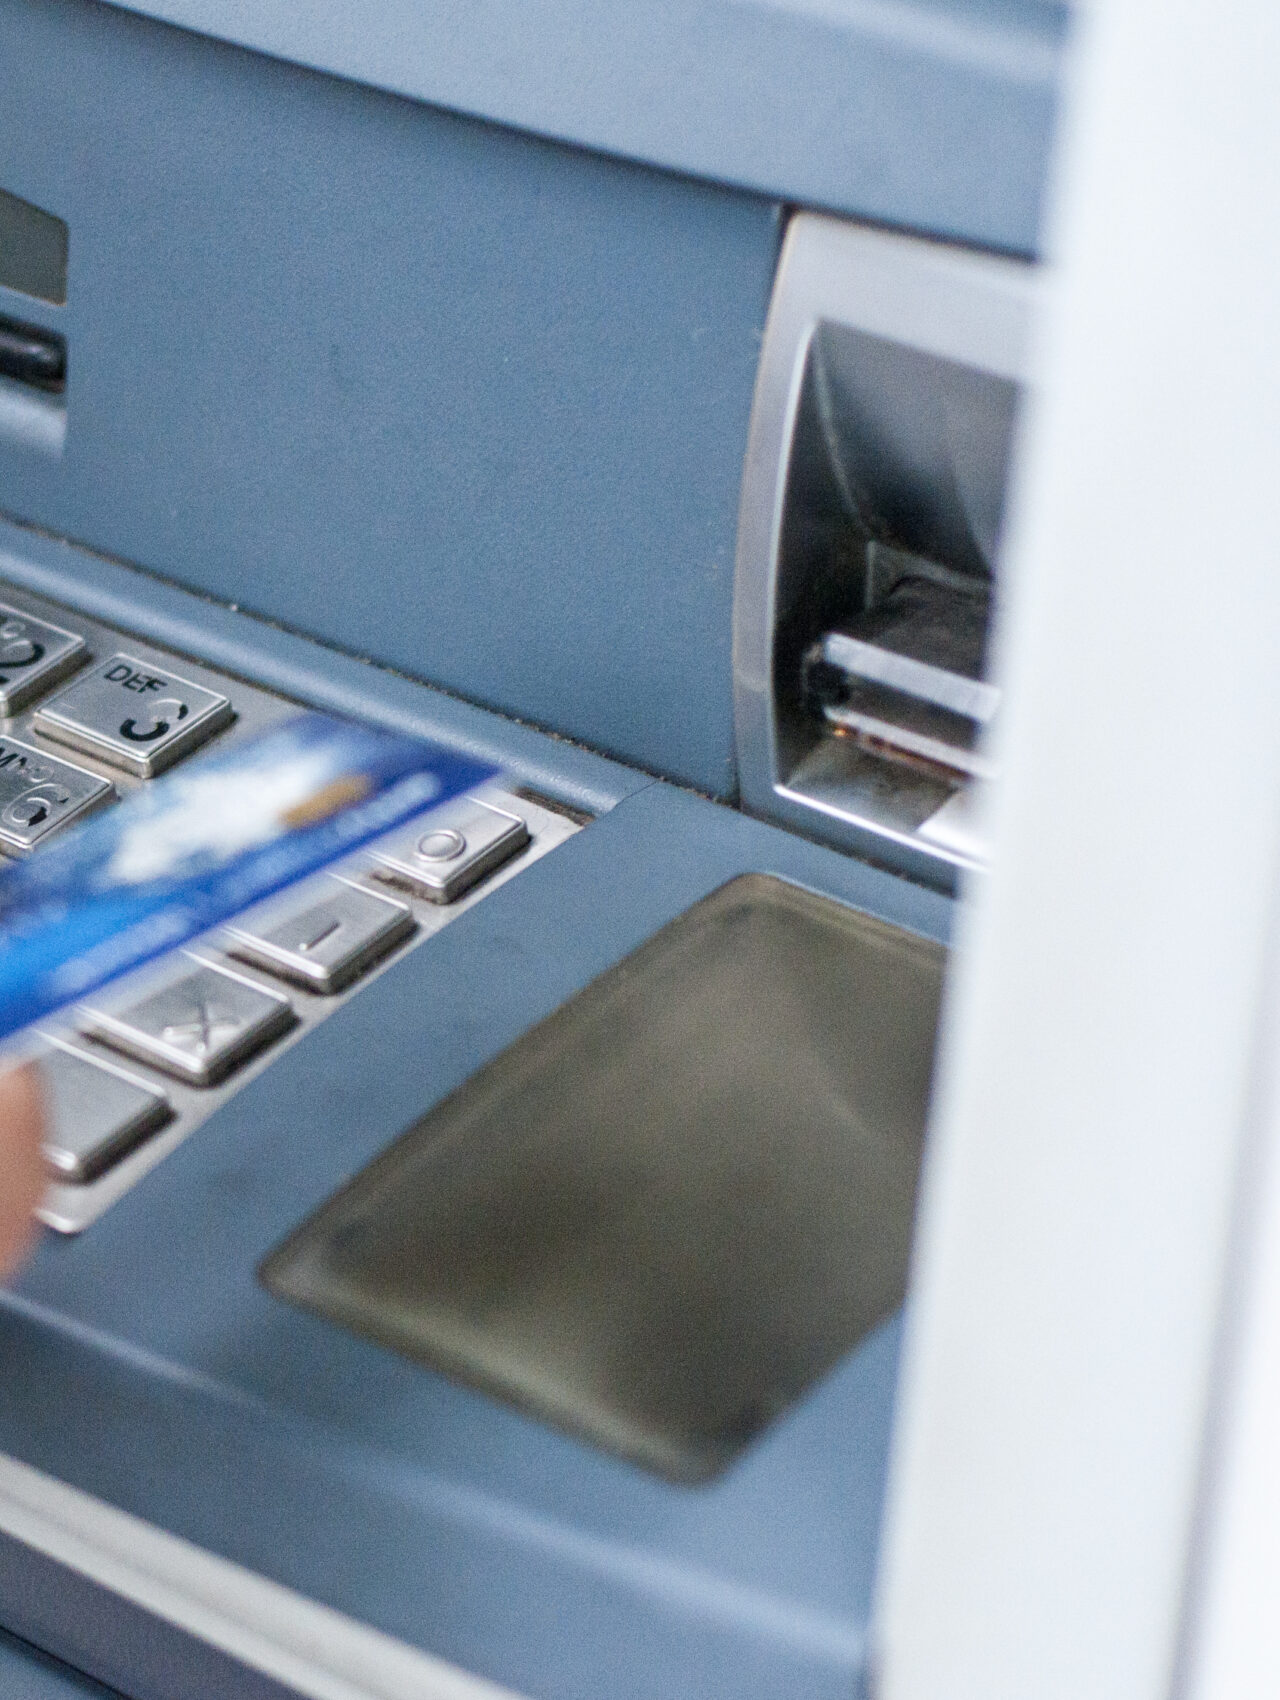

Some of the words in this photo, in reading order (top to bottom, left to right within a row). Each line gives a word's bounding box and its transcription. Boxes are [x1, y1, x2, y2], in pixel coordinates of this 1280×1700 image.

[104, 664, 168, 693] DEF
[120, 698, 188, 742] 3
[1, 783, 70, 828] 6
